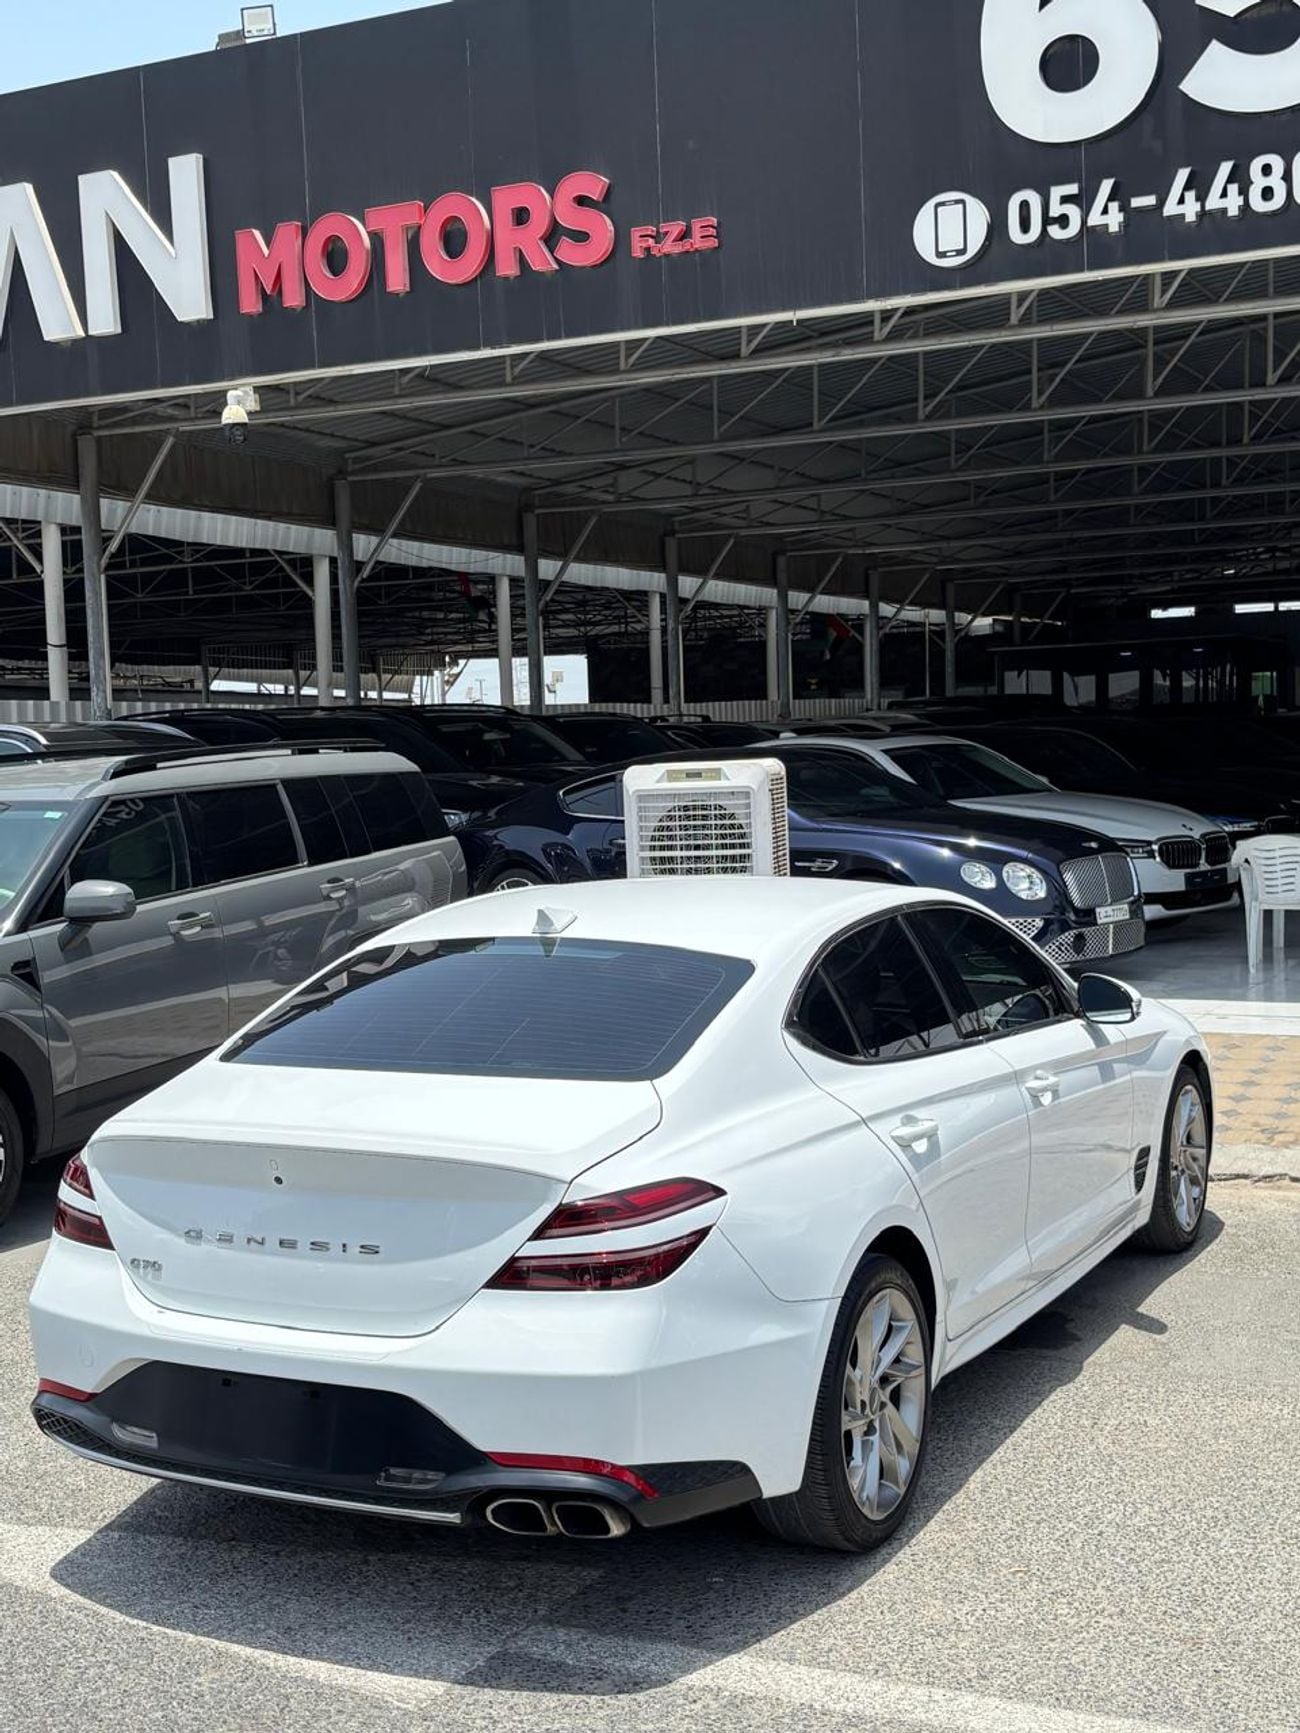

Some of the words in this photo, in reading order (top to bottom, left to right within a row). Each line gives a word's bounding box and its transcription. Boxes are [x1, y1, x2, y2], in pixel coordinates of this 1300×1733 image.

[235, 171, 615, 315] MOTORS
[1007, 151, 1300, 245] 054-448
[184, 1228, 381, 1255] GENESIS
